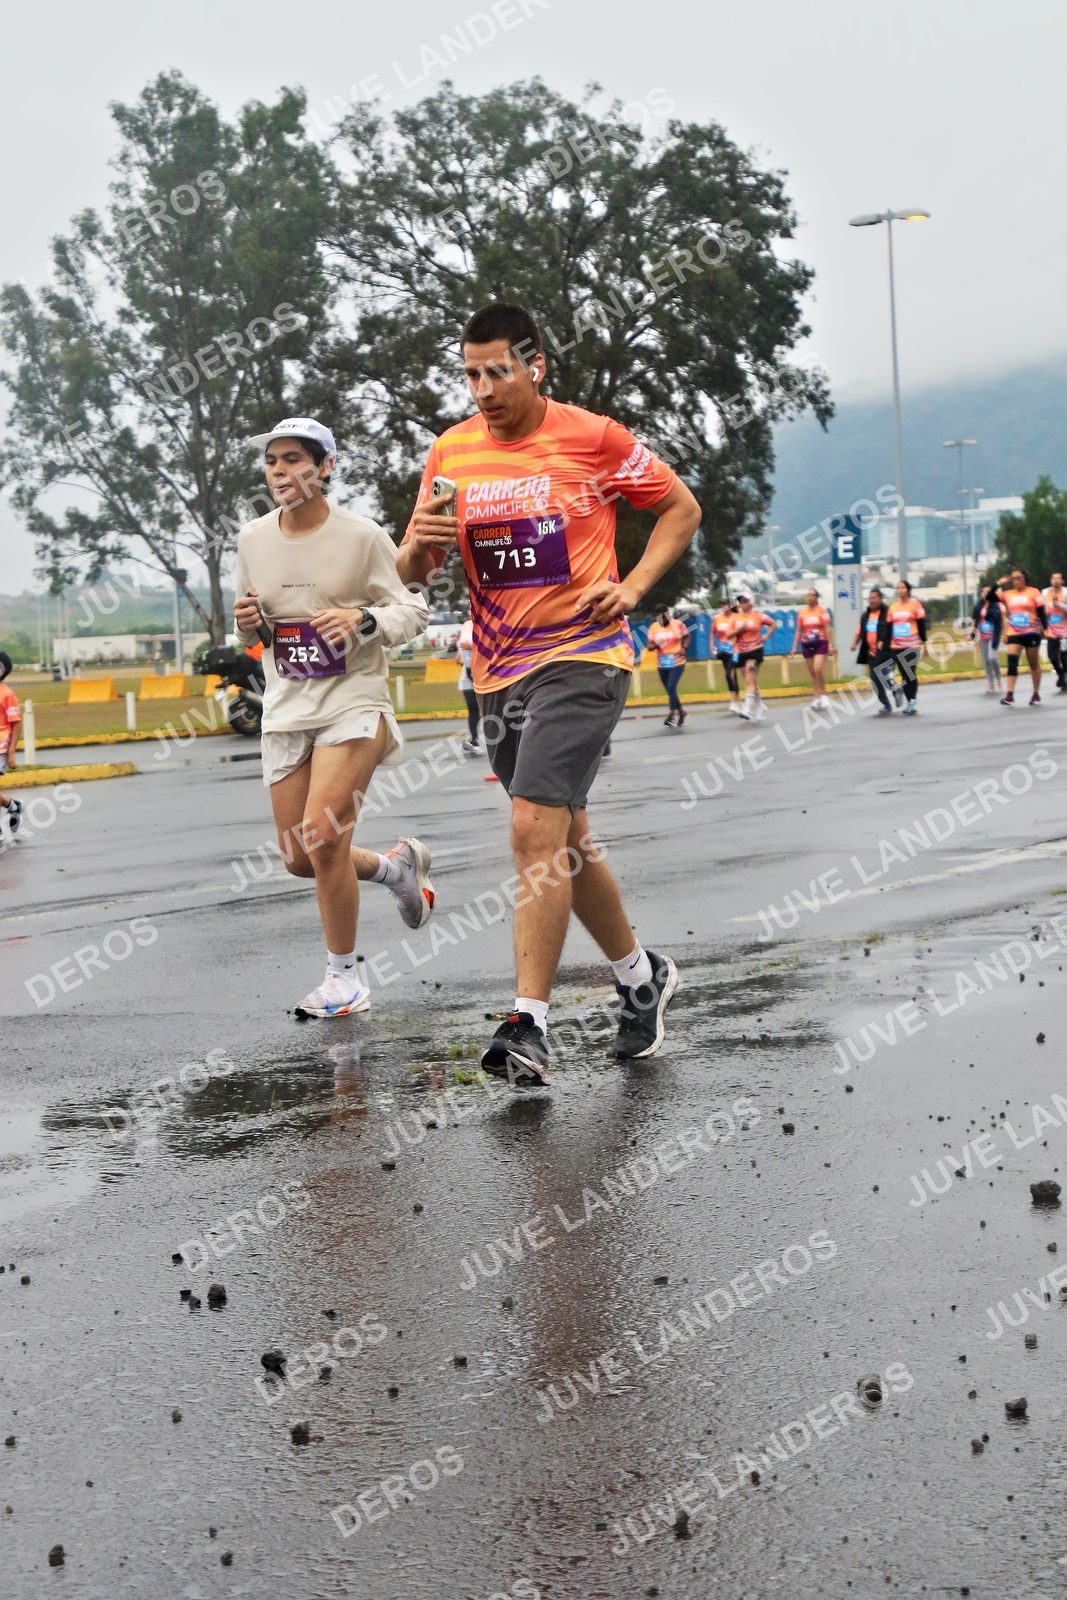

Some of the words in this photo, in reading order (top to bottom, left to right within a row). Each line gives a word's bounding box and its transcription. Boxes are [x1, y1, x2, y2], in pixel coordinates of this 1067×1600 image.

[466, 475, 550, 503] CARRERA
[473, 526, 512, 540] CARRERA
[538, 520, 556, 535] 15K
[838, 536, 854, 558] E
[494, 548, 537, 569] 713
[288, 646, 320, 663] 252
